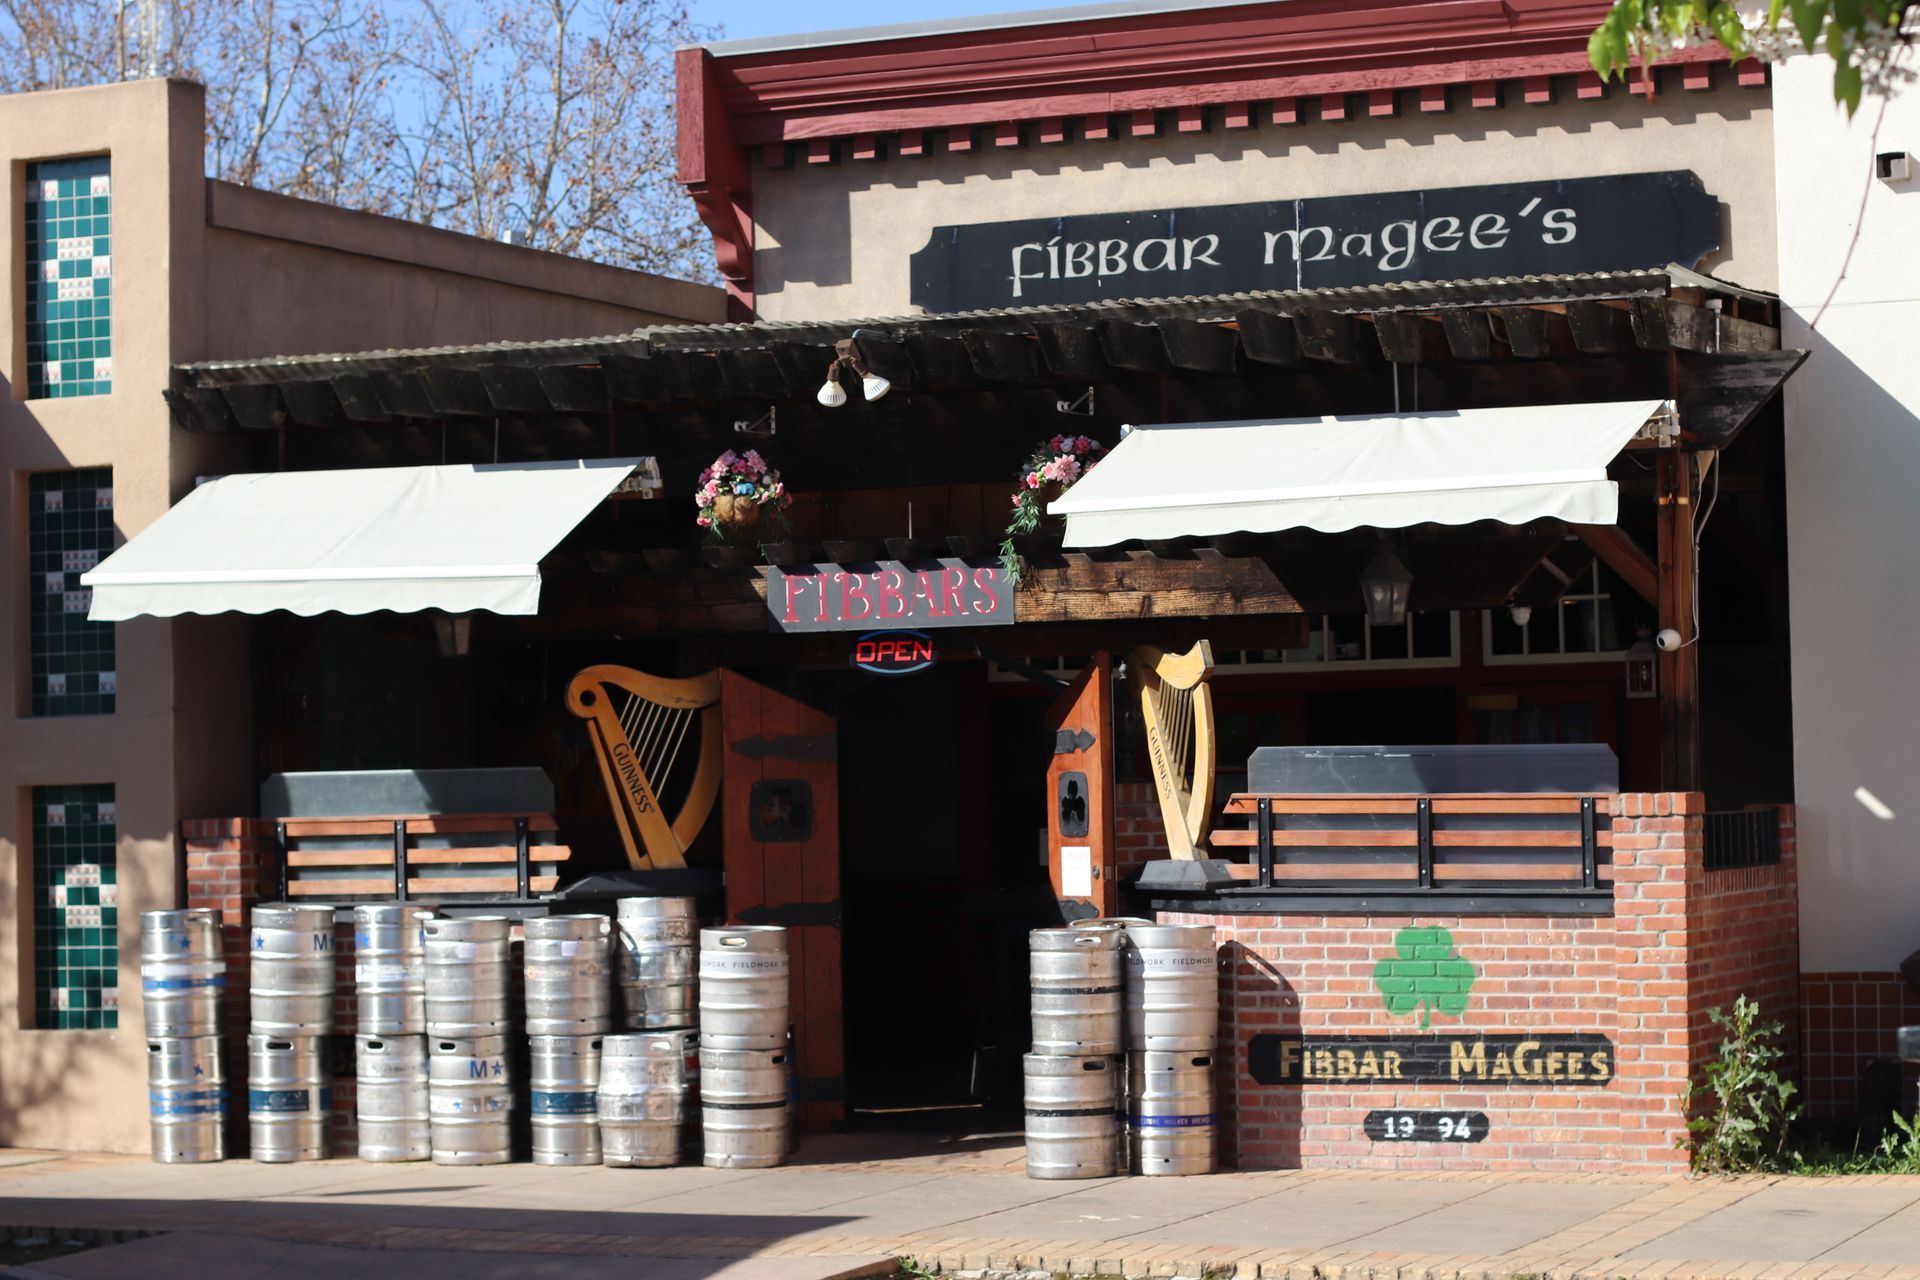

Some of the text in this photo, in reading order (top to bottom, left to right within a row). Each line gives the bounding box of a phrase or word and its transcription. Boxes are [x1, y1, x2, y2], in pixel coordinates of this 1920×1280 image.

[781, 567, 1000, 623] FIBBARS
[855, 640, 933, 663] OPEN
[612, 742, 653, 814] GUINNESS
[1149, 726, 1173, 800] GUINNESS
[732, 960, 778, 969] FIELDWORK
[1438, 1116, 1472, 1139] 94
